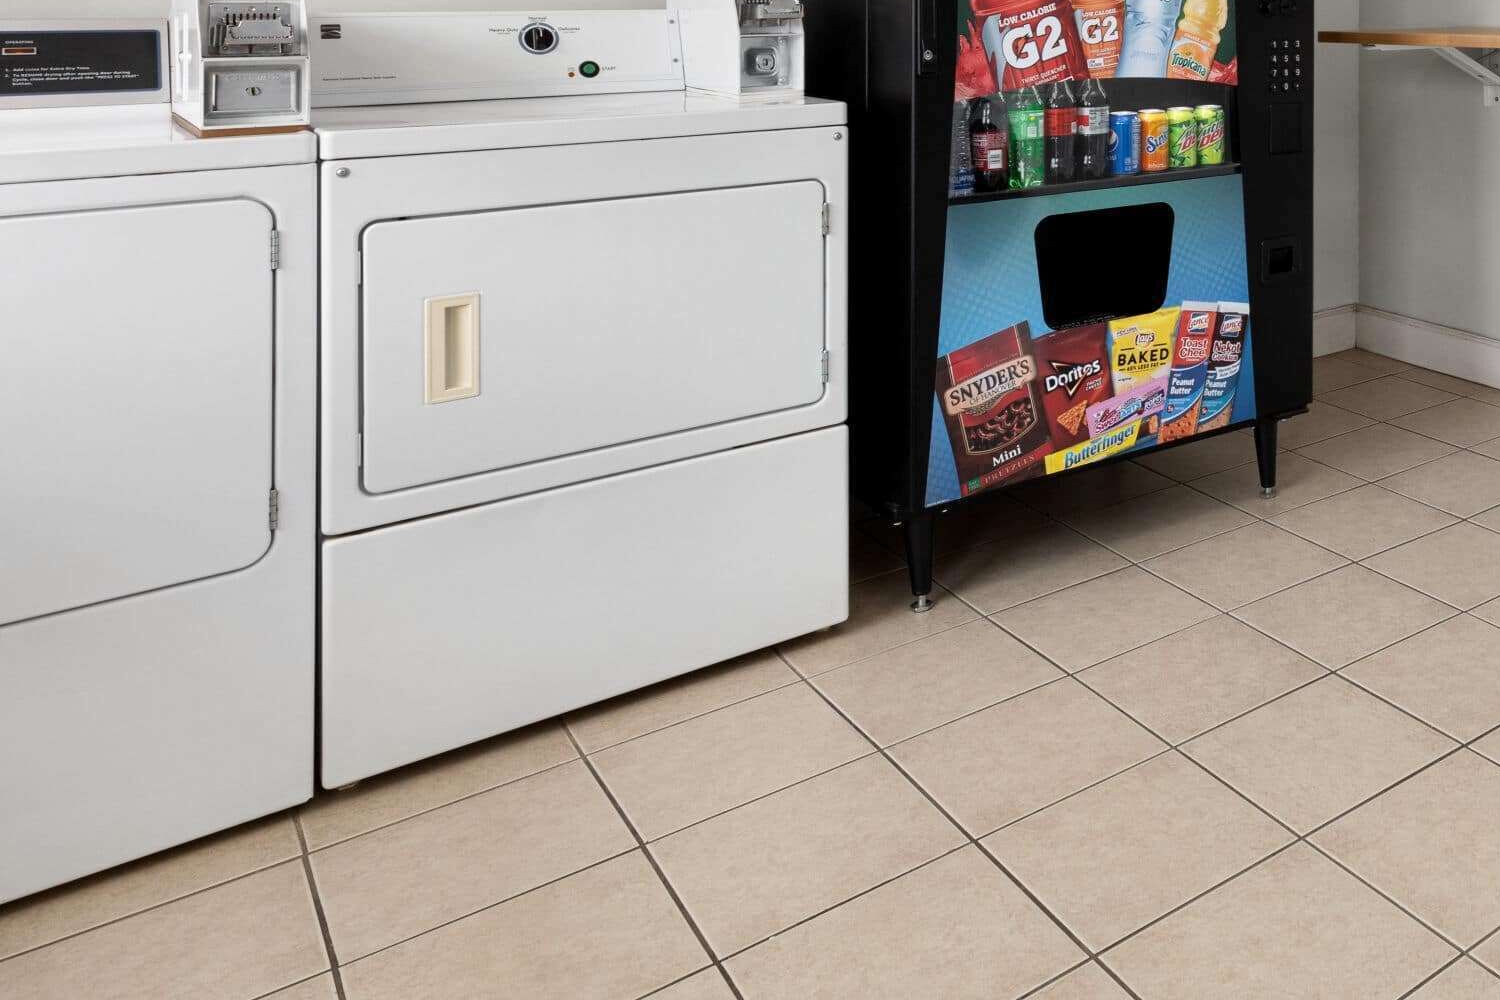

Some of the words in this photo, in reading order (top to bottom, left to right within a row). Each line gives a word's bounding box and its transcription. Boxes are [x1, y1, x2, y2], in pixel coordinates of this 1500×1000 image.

[998, 16, 1018, 27] LOW
[1020, 2, 1057, 19] CALORIE
[1081, 16, 1119, 44] G2
[1002, 16, 1068, 69] G2
[1171, 52, 1207, 77] Tropicana
[1181, 337, 1208, 348] Toast
[1118, 348, 1169, 366] BAKED
[950, 360, 1029, 406] SNYDER'S
[1045, 360, 1101, 392] Doritos
[1172, 378, 1194, 386] Peanut
[1205, 379, 1227, 388] Peanut
[1171, 387, 1191, 395] Butter
[1204, 389, 1224, 397] Butter
[992, 445, 1022, 467] Mini
[1065, 425, 1134, 468] Butterfinger
